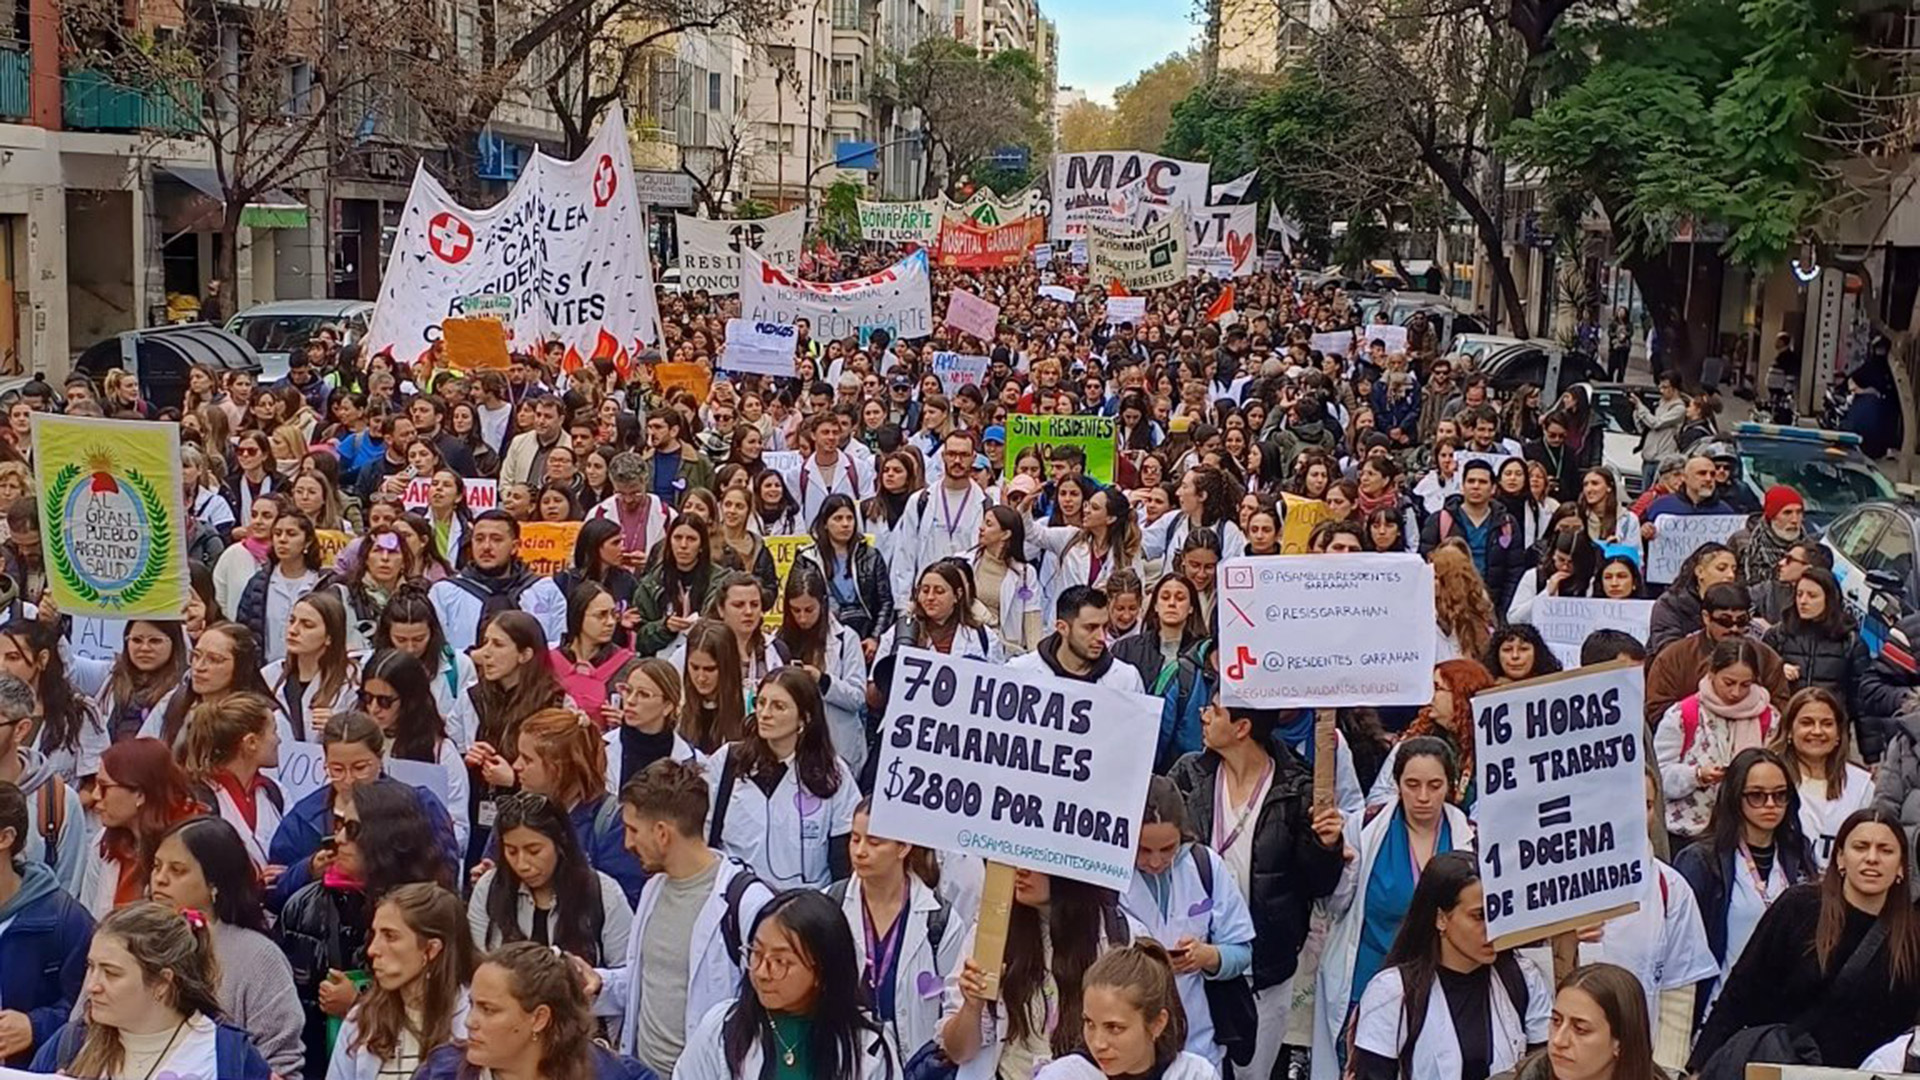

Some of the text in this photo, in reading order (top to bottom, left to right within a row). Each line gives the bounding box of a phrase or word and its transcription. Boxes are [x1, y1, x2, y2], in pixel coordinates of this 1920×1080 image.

[1066, 155, 1181, 196] MAC
[861, 212, 934, 229] BONAPARTE
[871, 229, 923, 239] EN LUCHA
[942, 226, 981, 253] HOSPITAL
[90, 493, 111, 510] AL
[86, 508, 131, 528] GRAN
[86, 525, 138, 543] PUEBLO
[74, 541, 138, 560] ARGENTINO
[86, 558, 129, 580] SALUD
[1266, 604, 1389, 622] @RESISGARRAHAN
[81, 617, 113, 649] AL
[903, 656, 1093, 735] 70 HORAS
[1478, 688, 1621, 746] 16 HORAS
[891, 714, 1093, 782] SEMANALES
[1485, 733, 1636, 795] DE TRABAJO
[884, 756, 1130, 849] $2800 POR HORA
[1485, 821, 1615, 879] 1 DOCENA
[1486, 859, 1643, 923] DE EMPANADAS
